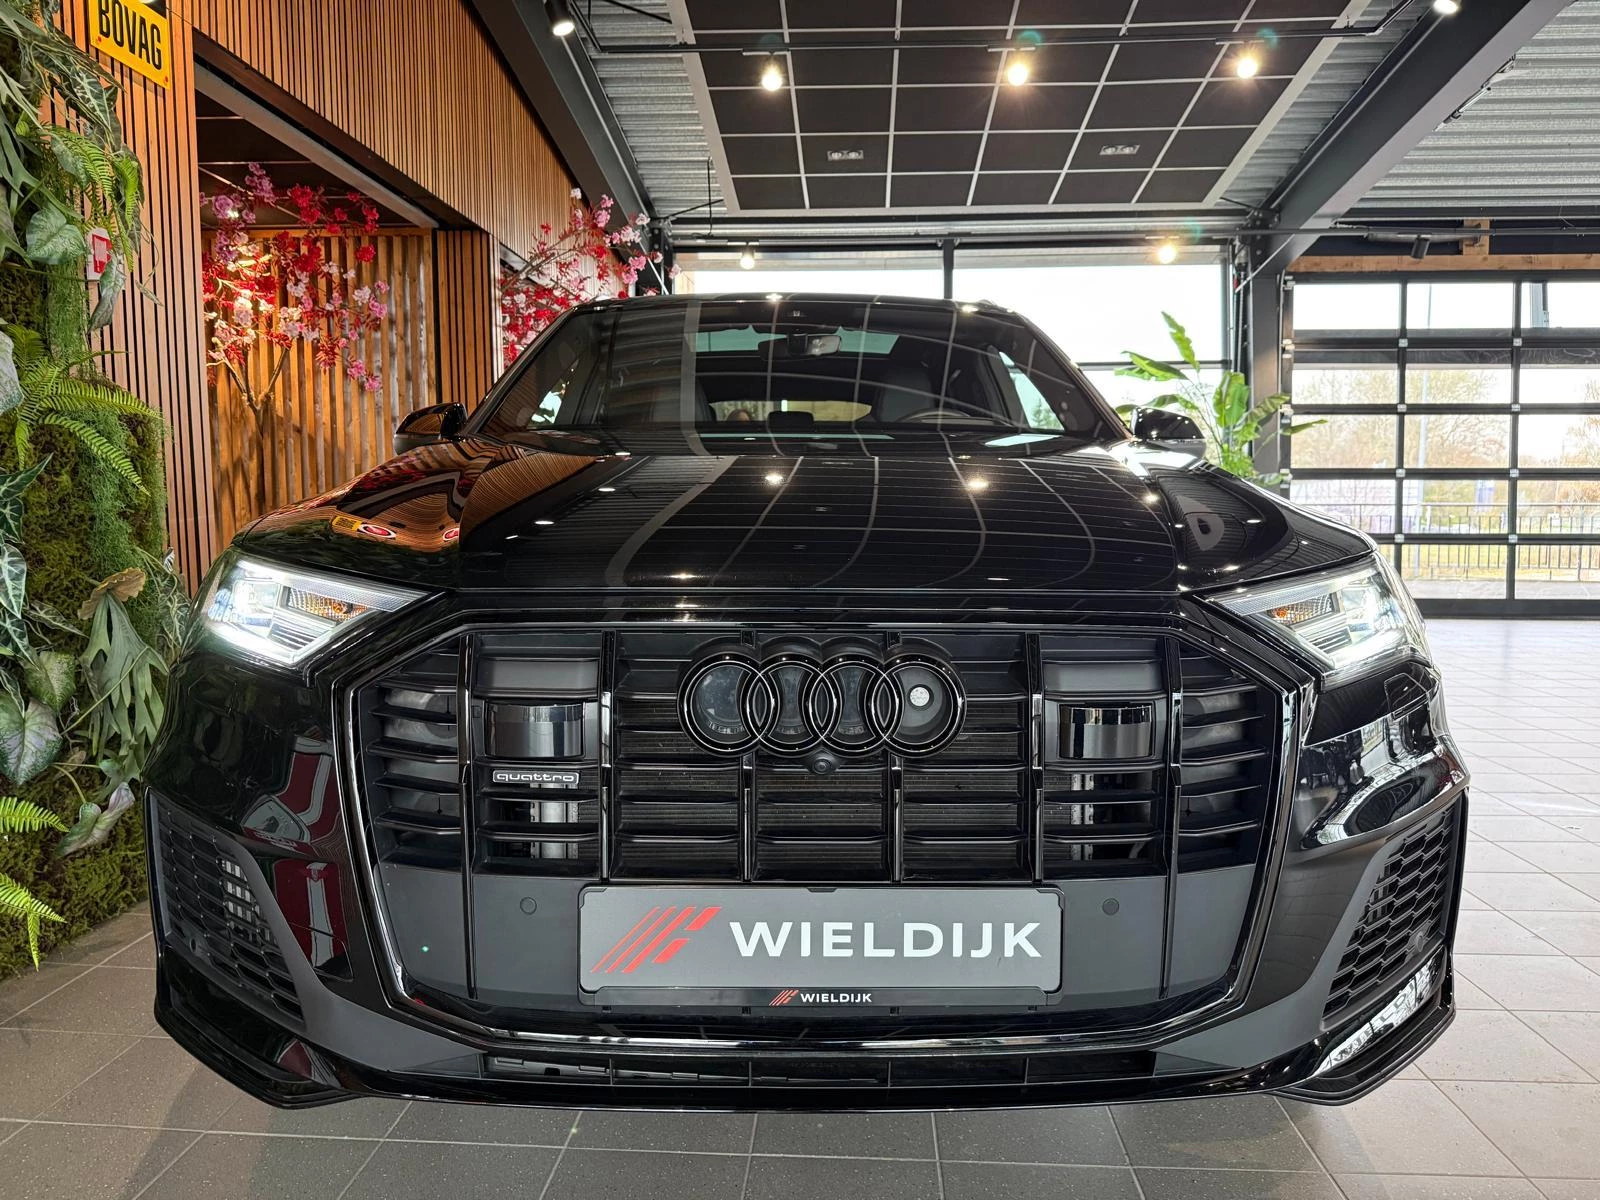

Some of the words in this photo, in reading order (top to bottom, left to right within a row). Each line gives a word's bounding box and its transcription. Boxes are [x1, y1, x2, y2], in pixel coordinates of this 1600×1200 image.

[98, 0, 162, 70] BOVAG
[496, 773, 575, 782] quattro
[729, 921, 1042, 958] WIELDIJK
[800, 993, 873, 1003] WIELDIJK
